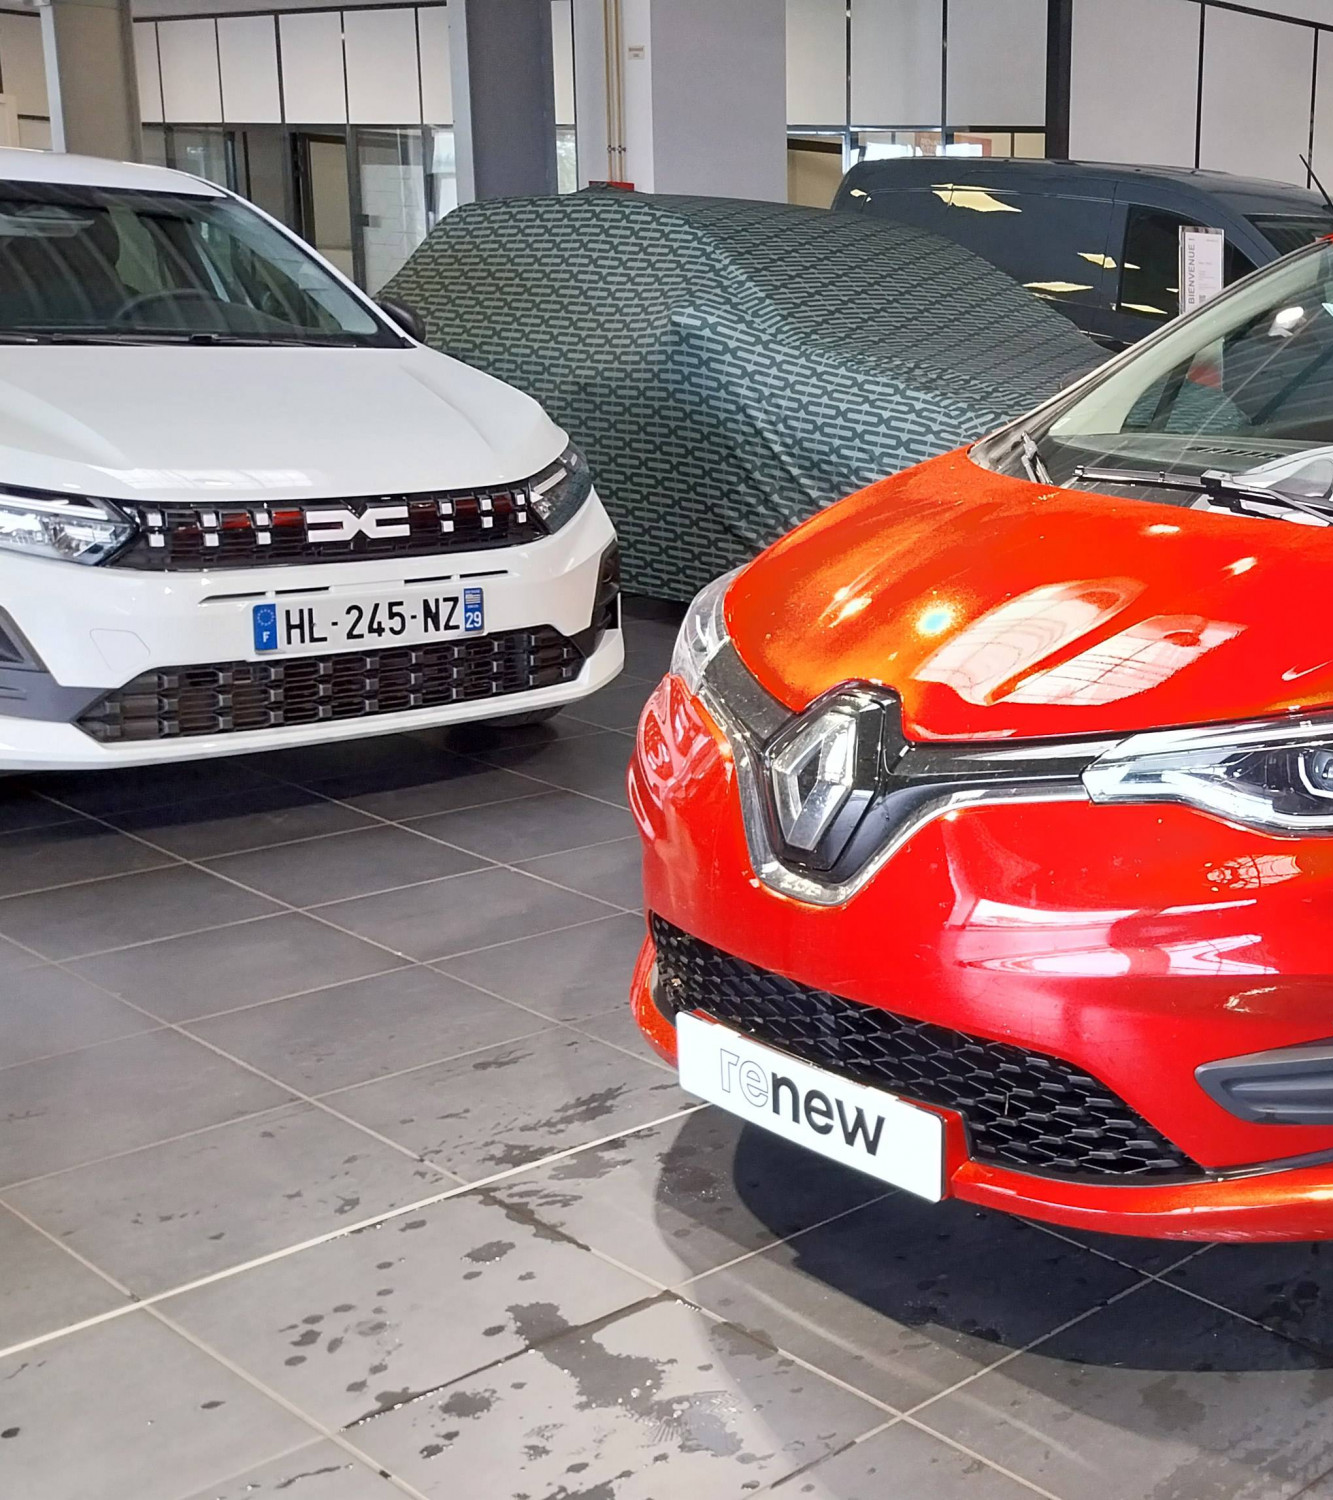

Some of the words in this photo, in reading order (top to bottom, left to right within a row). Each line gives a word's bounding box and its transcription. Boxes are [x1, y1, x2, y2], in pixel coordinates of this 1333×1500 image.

[1187, 244, 1196, 304] BIENVENUE
[262, 631, 271, 644] F
[465, 611, 482, 629] 29
[720, 1047, 886, 1157] renew
